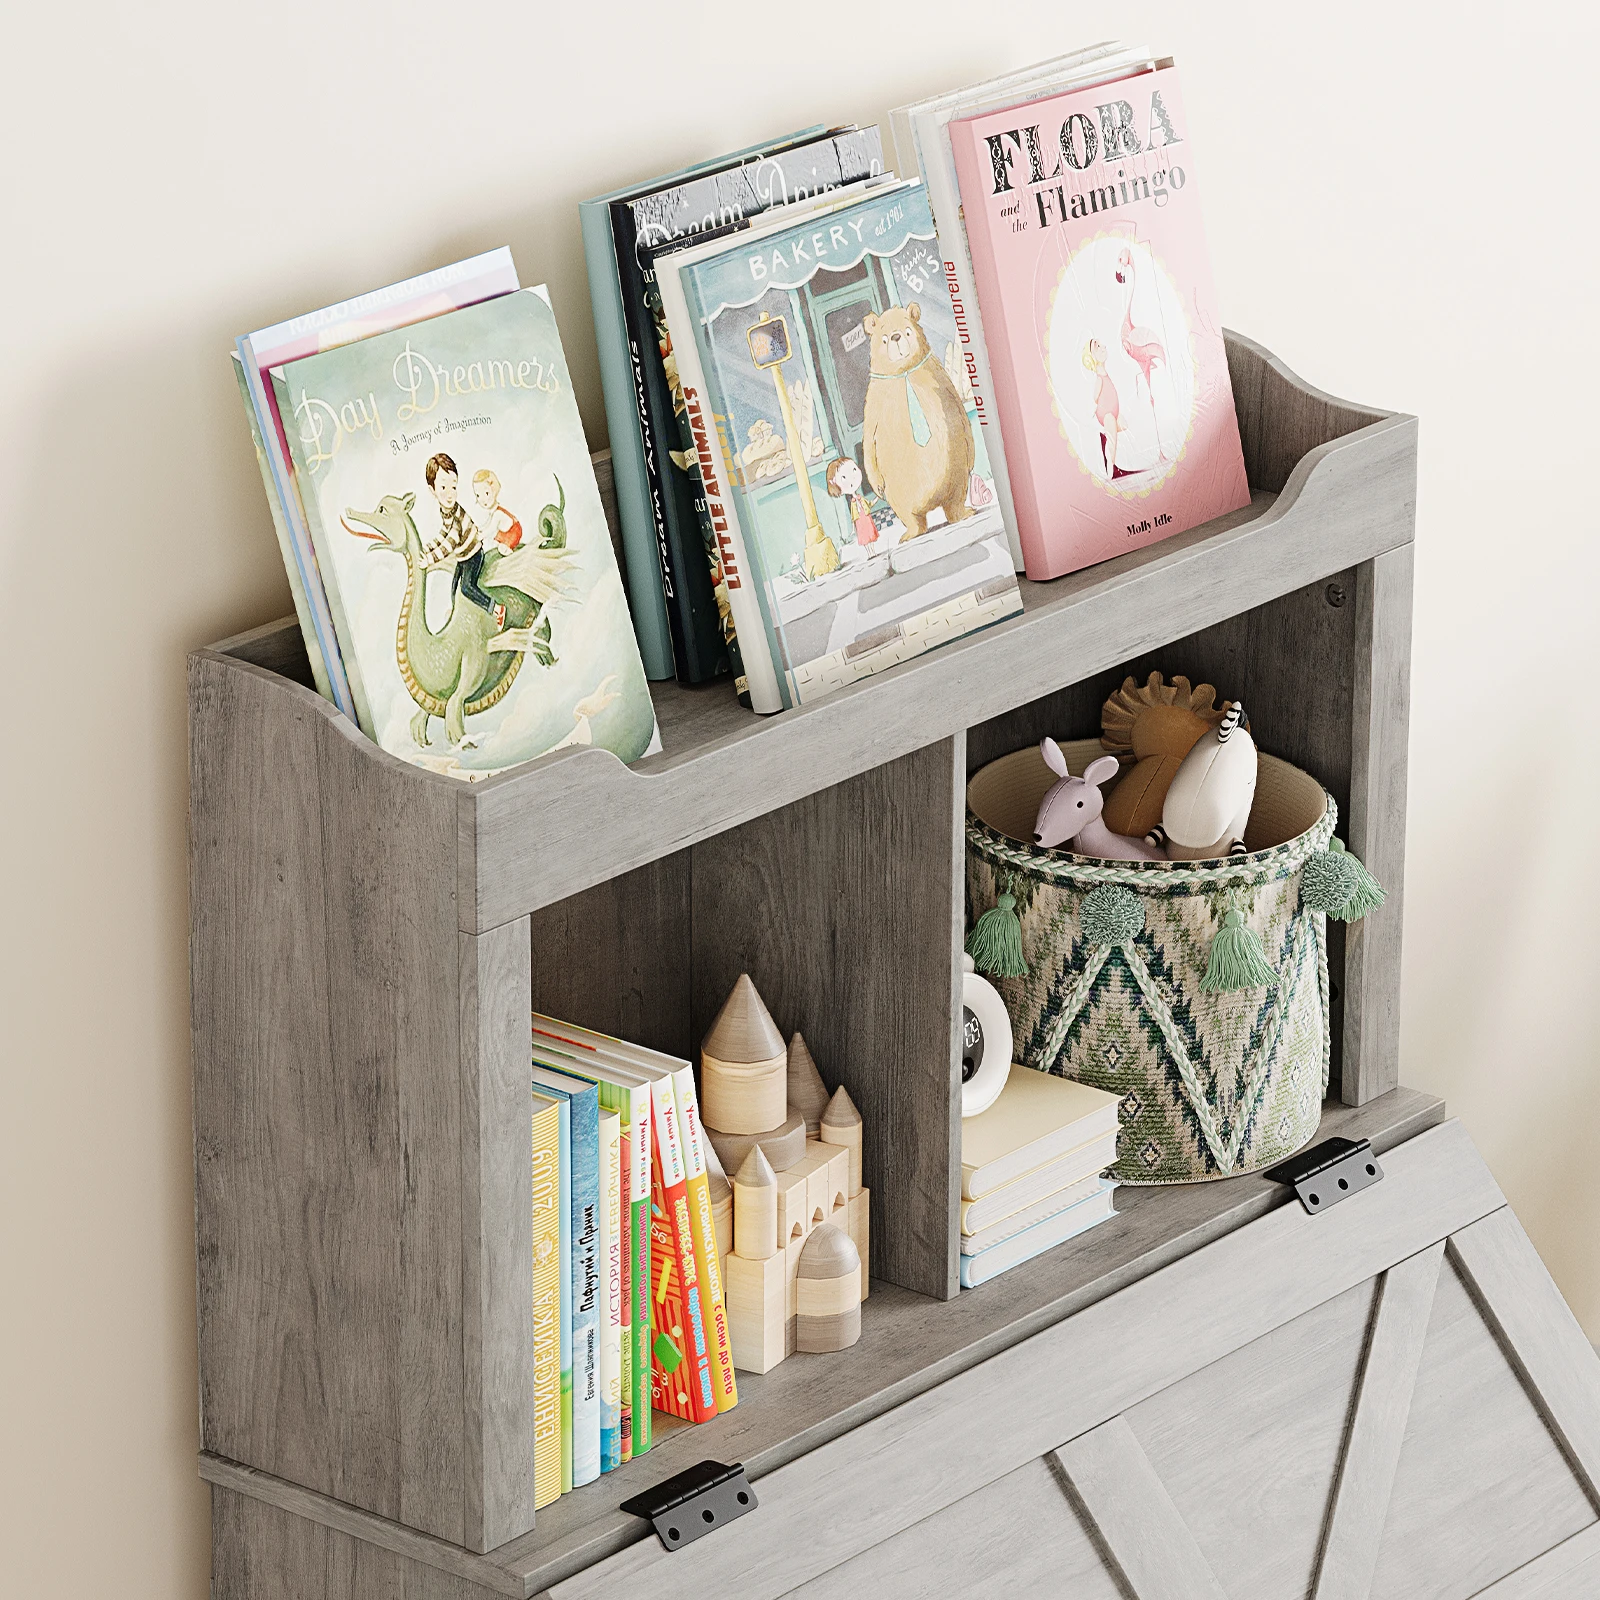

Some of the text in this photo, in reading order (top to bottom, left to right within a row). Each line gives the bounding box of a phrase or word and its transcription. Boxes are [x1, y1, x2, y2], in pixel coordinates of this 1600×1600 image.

[983, 89, 1184, 196] FLORA
[874, 201, 905, 237] est 1901
[1000, 200, 1028, 233] and the
[1033, 166, 1186, 229] Flamingo
[748, 218, 864, 281] BAKERY
[899, 247, 927, 281] fresh
[906, 253, 940, 294] BIS
[294, 340, 561, 474] Day Dreamers
[390, 414, 492, 455] A Journey of Imagination
[683, 386, 722, 498] ANIMALS
[630, 340, 675, 599] Dream Animals
[710, 502, 742, 590] LITTLE
[1127, 513, 1172, 537] Molly Idle
[532, 1148, 553, 1216] 2009
[609, 1138, 620, 1236] ГЕВЕЙЧИКА
[579, 1204, 599, 1313] Пафнутий и Пряник
[639, 1203, 648, 1321] ЭНЦИКЛОПЕДИЯ РОДИТЕЛЕЙ
[675, 1195, 696, 1286] ЭКСПРЕСС-КУРС
[696, 1184, 722, 1304] ГОТОВИМСЯ К ШКОЛЕ
[609, 1245, 621, 1327] ИСТОРИЯ
[584, 1327, 596, 1402] Евгения Шляпникова
[640, 1324, 649, 1369] будущего
[688, 1286, 706, 1357] подготовки
[699, 1367, 713, 1408] школе
[714, 1313, 727, 1348] осени
[718, 1350, 729, 1365] до
[722, 1366, 733, 1395] лета
